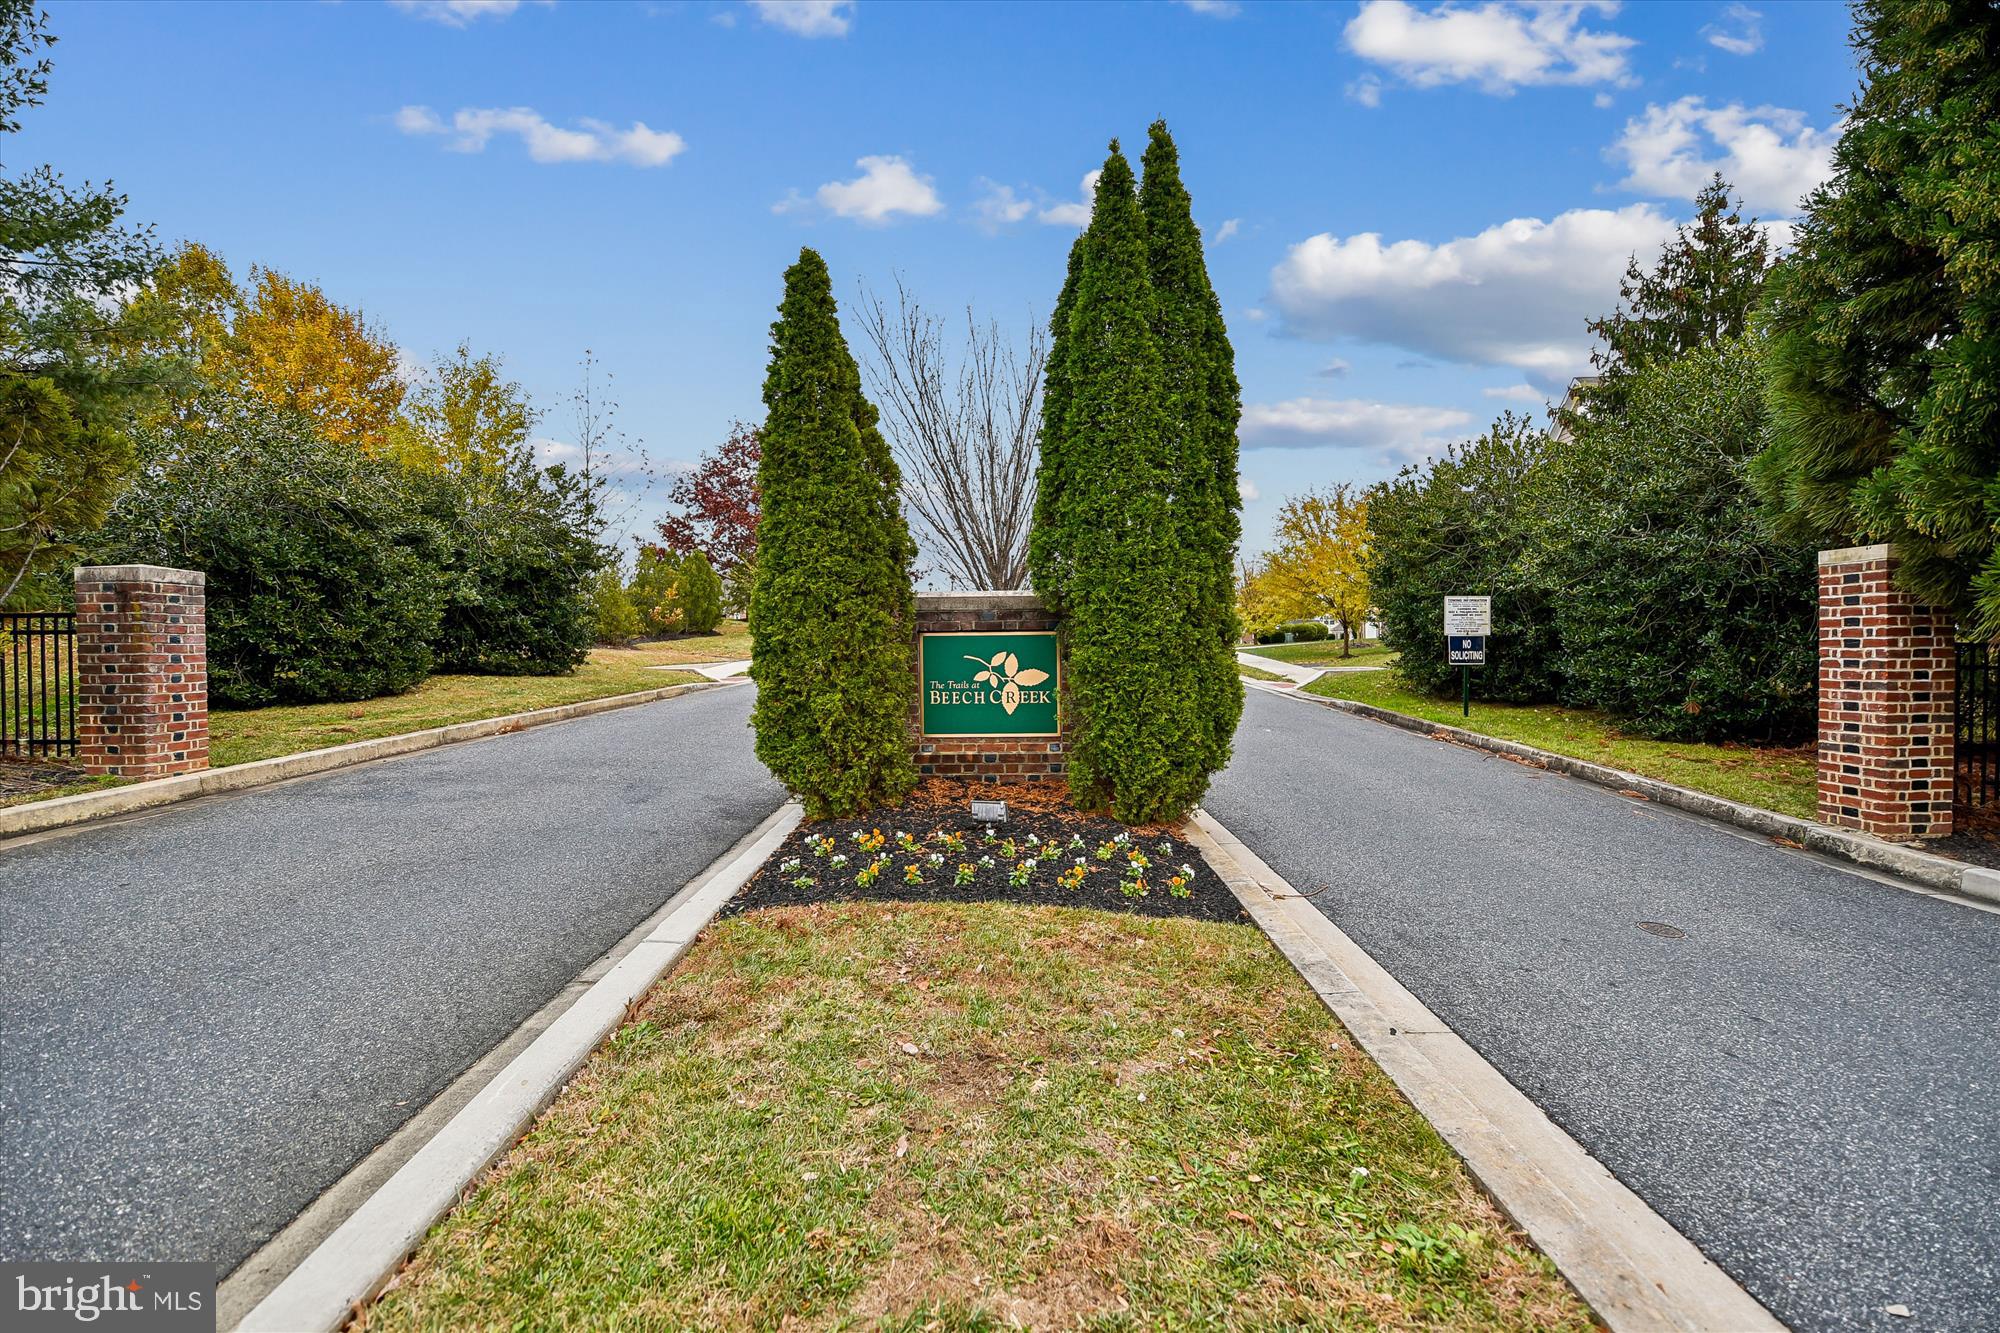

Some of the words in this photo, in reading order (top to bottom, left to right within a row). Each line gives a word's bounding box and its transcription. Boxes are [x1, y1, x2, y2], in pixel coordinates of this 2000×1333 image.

[1462, 640, 1472, 649] NO
[1450, 651, 1483, 660] SOLICITING
[930, 680, 945, 689] The
[947, 680, 970, 689] Trails
[930, 690, 986, 704] BEECH
[989, 690, 1052, 704] CREEK
